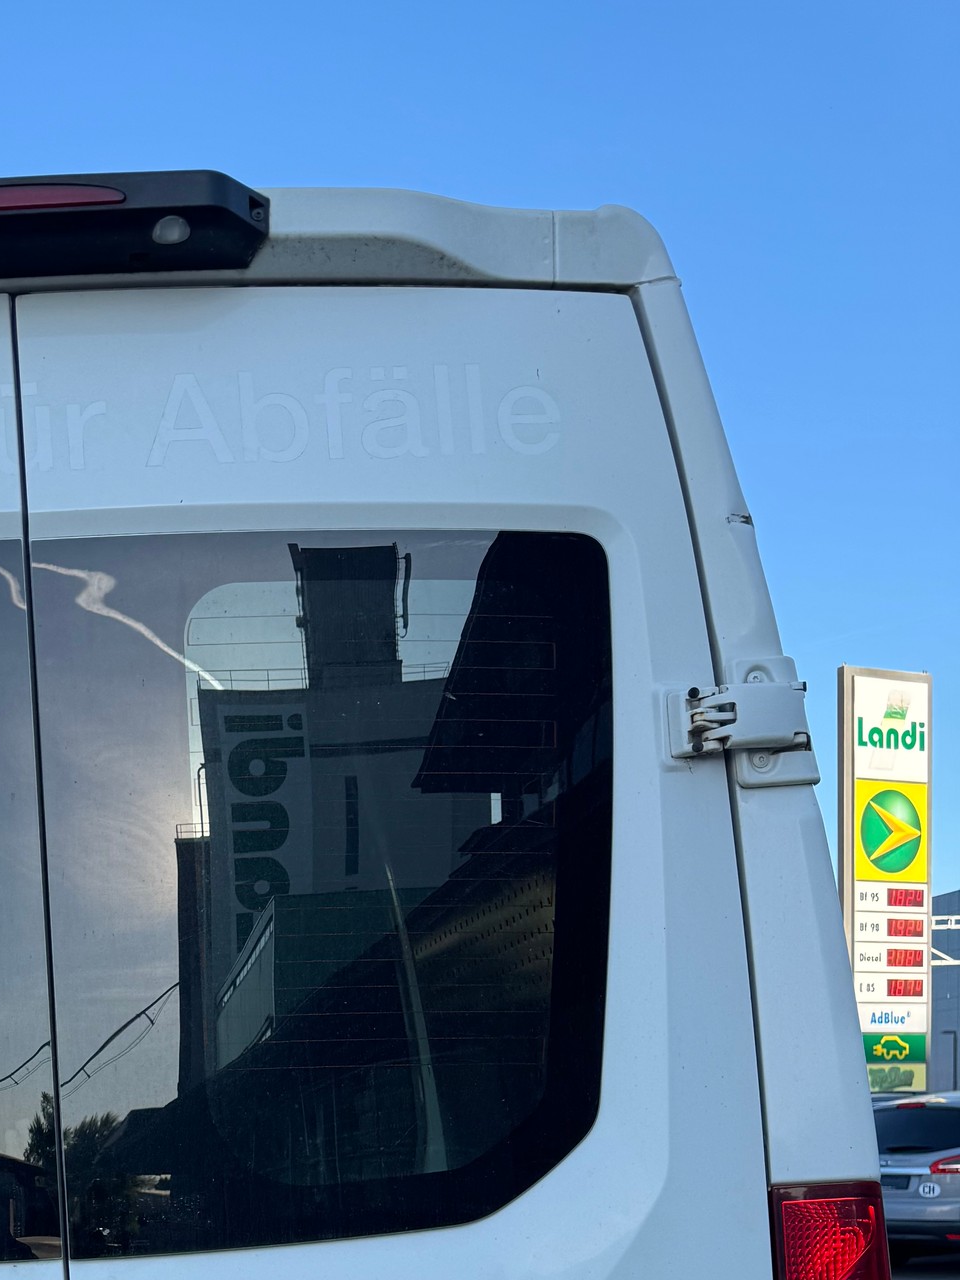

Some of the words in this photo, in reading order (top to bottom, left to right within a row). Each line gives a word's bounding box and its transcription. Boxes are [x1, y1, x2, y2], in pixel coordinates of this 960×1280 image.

[145, 362, 563, 470] Abfälle
[857, 716, 925, 752] Landi
[870, 892, 880, 902] 95
[870, 923, 880, 933] 98
[922, 1184, 936, 1195] CH
